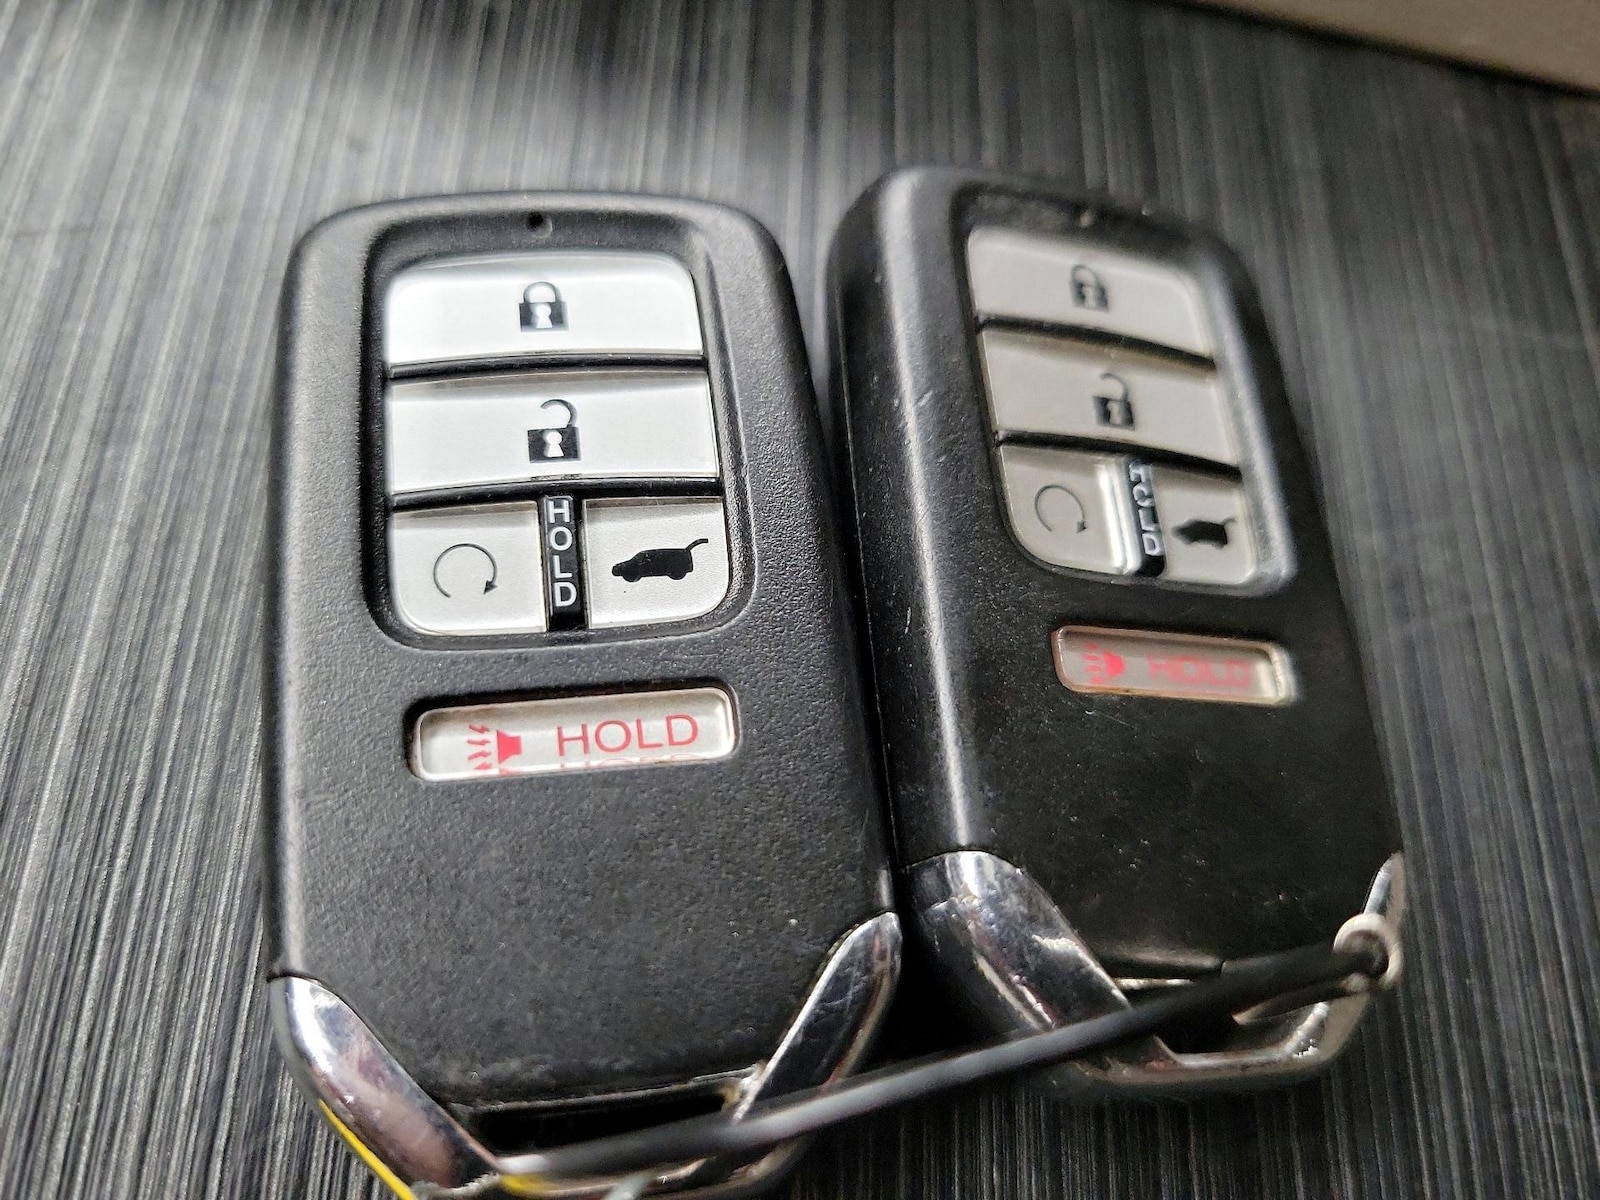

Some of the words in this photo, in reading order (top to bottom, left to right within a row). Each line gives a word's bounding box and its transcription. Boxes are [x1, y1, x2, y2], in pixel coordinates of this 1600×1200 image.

[548, 500, 577, 608] HOLD
[1147, 655, 1252, 687] HOLD
[556, 714, 698, 757] HOLD
